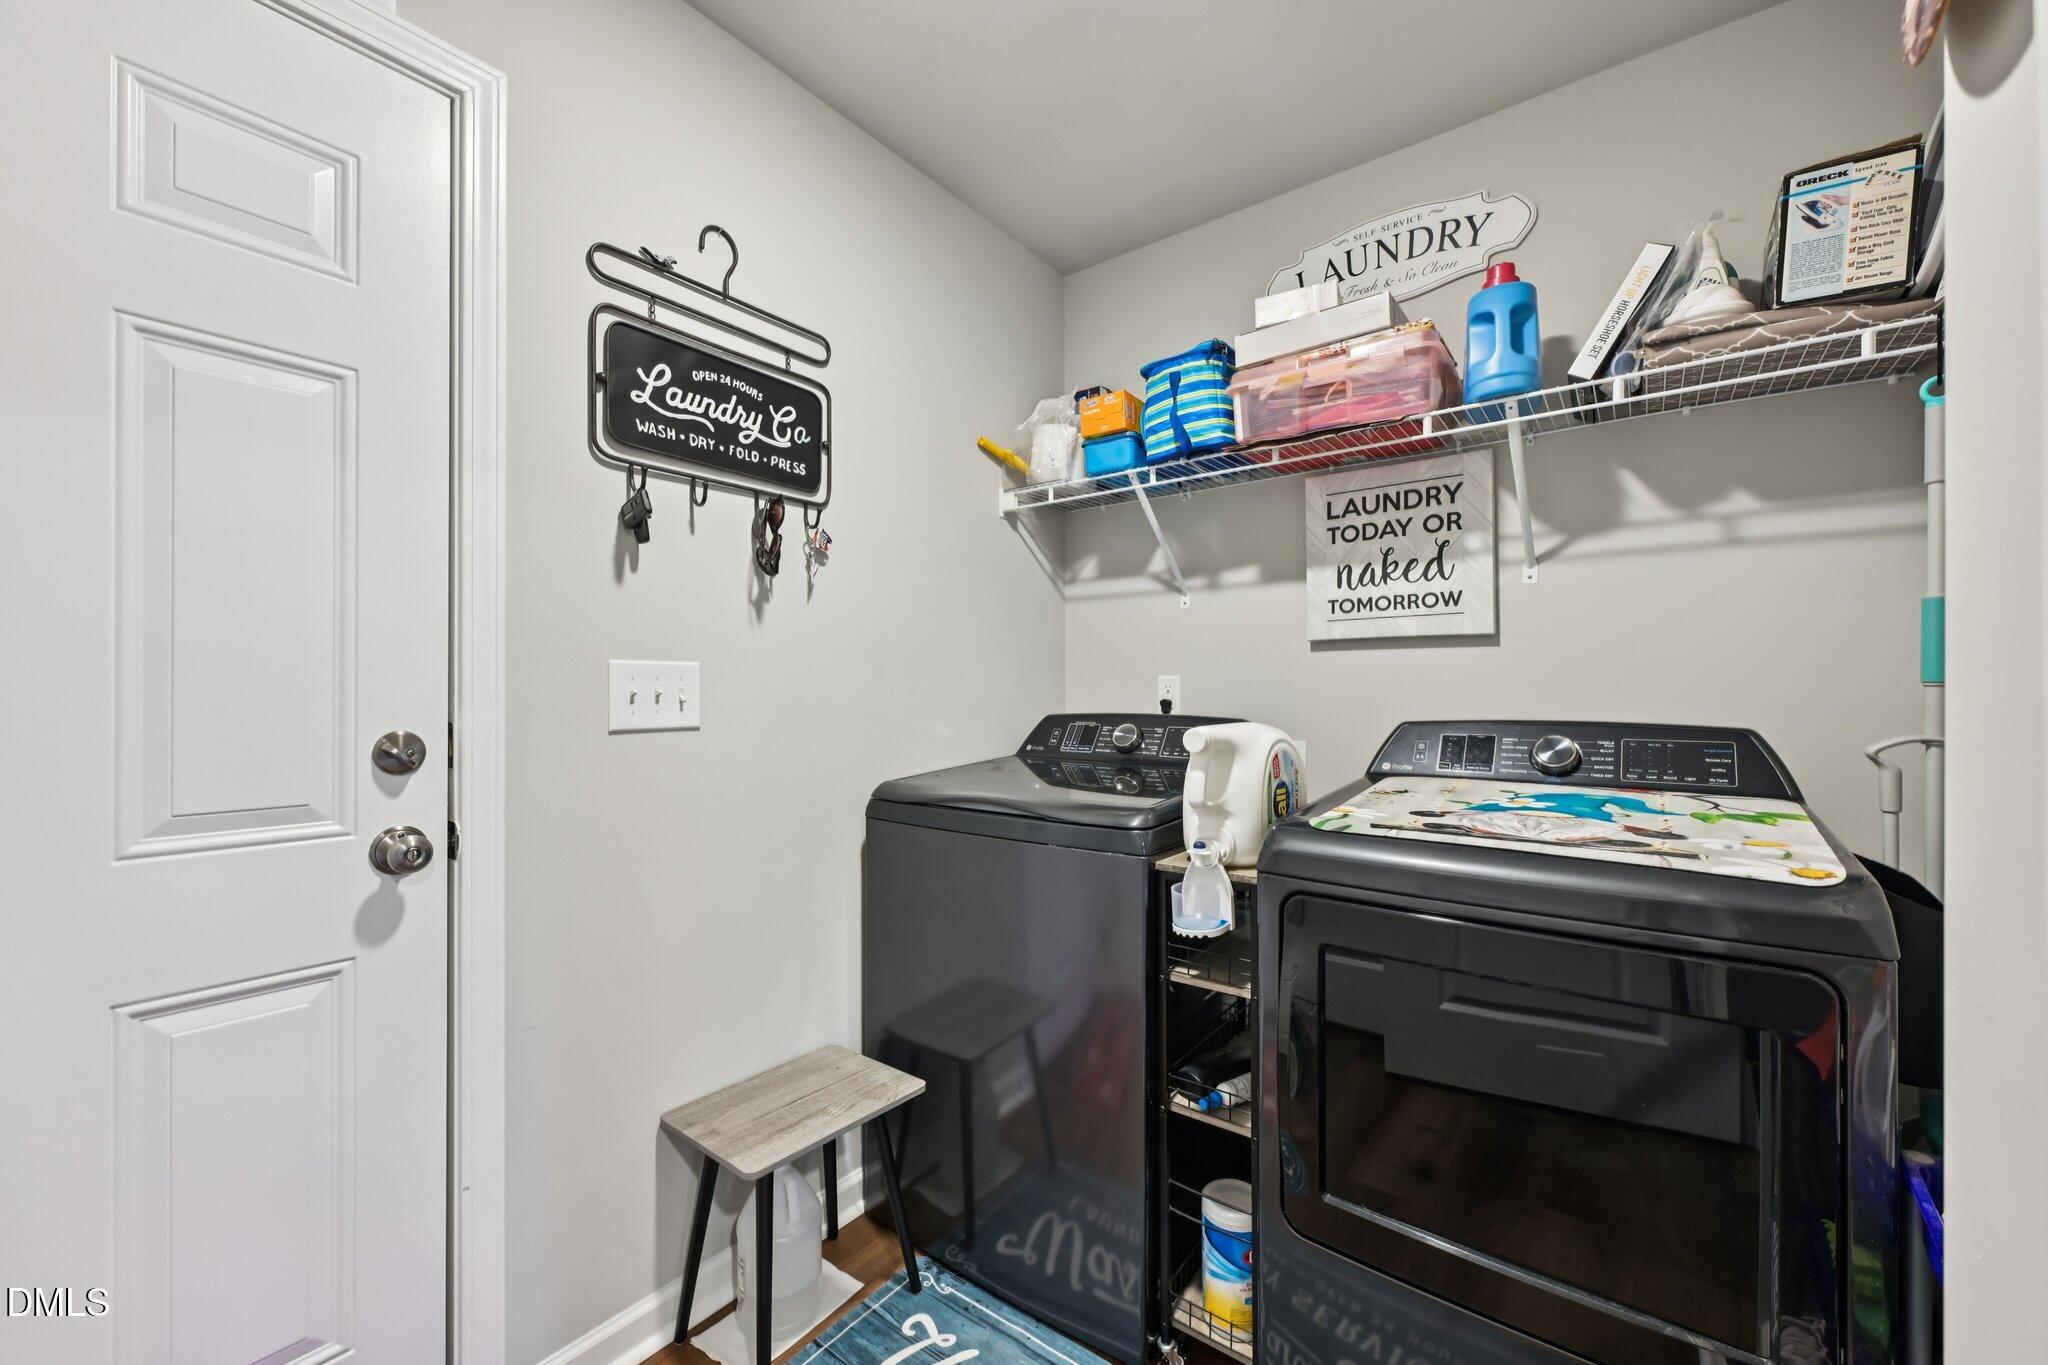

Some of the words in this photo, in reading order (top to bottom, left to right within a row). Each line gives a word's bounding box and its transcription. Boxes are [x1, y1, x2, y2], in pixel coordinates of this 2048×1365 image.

[1796, 169, 1849, 188] ORECK
[1877, 169, 1904, 180] FREE
[1342, 278, 1379, 299] Fresh
[1383, 277, 1395, 288] &
[1398, 267, 1417, 284] So
[1421, 259, 1459, 277] Clean
[1632, 265, 1652, 288] LIGHT
[1625, 288, 1637, 300] UP
[1597, 299, 1631, 345] HORSESHOE
[1588, 344, 1603, 360] SET
[692, 370, 718, 382] OPEN
[720, 374, 732, 387] 24
[732, 379, 764, 402] HOURS
[630, 363, 792, 448] Laundry
[769, 403, 812, 445] Co
[635, 418, 677, 441] WASH
[688, 433, 716, 451] DRY
[729, 445, 760, 463] FOLD
[770, 455, 807, 476] PRESS
[1326, 481, 1464, 521] LAUNDRY
[1326, 516, 1414, 545] TODAY
[1422, 510, 1463, 534] OR
[1336, 536, 1456, 591] naked
[1327, 590, 1464, 614] TOMORROW
